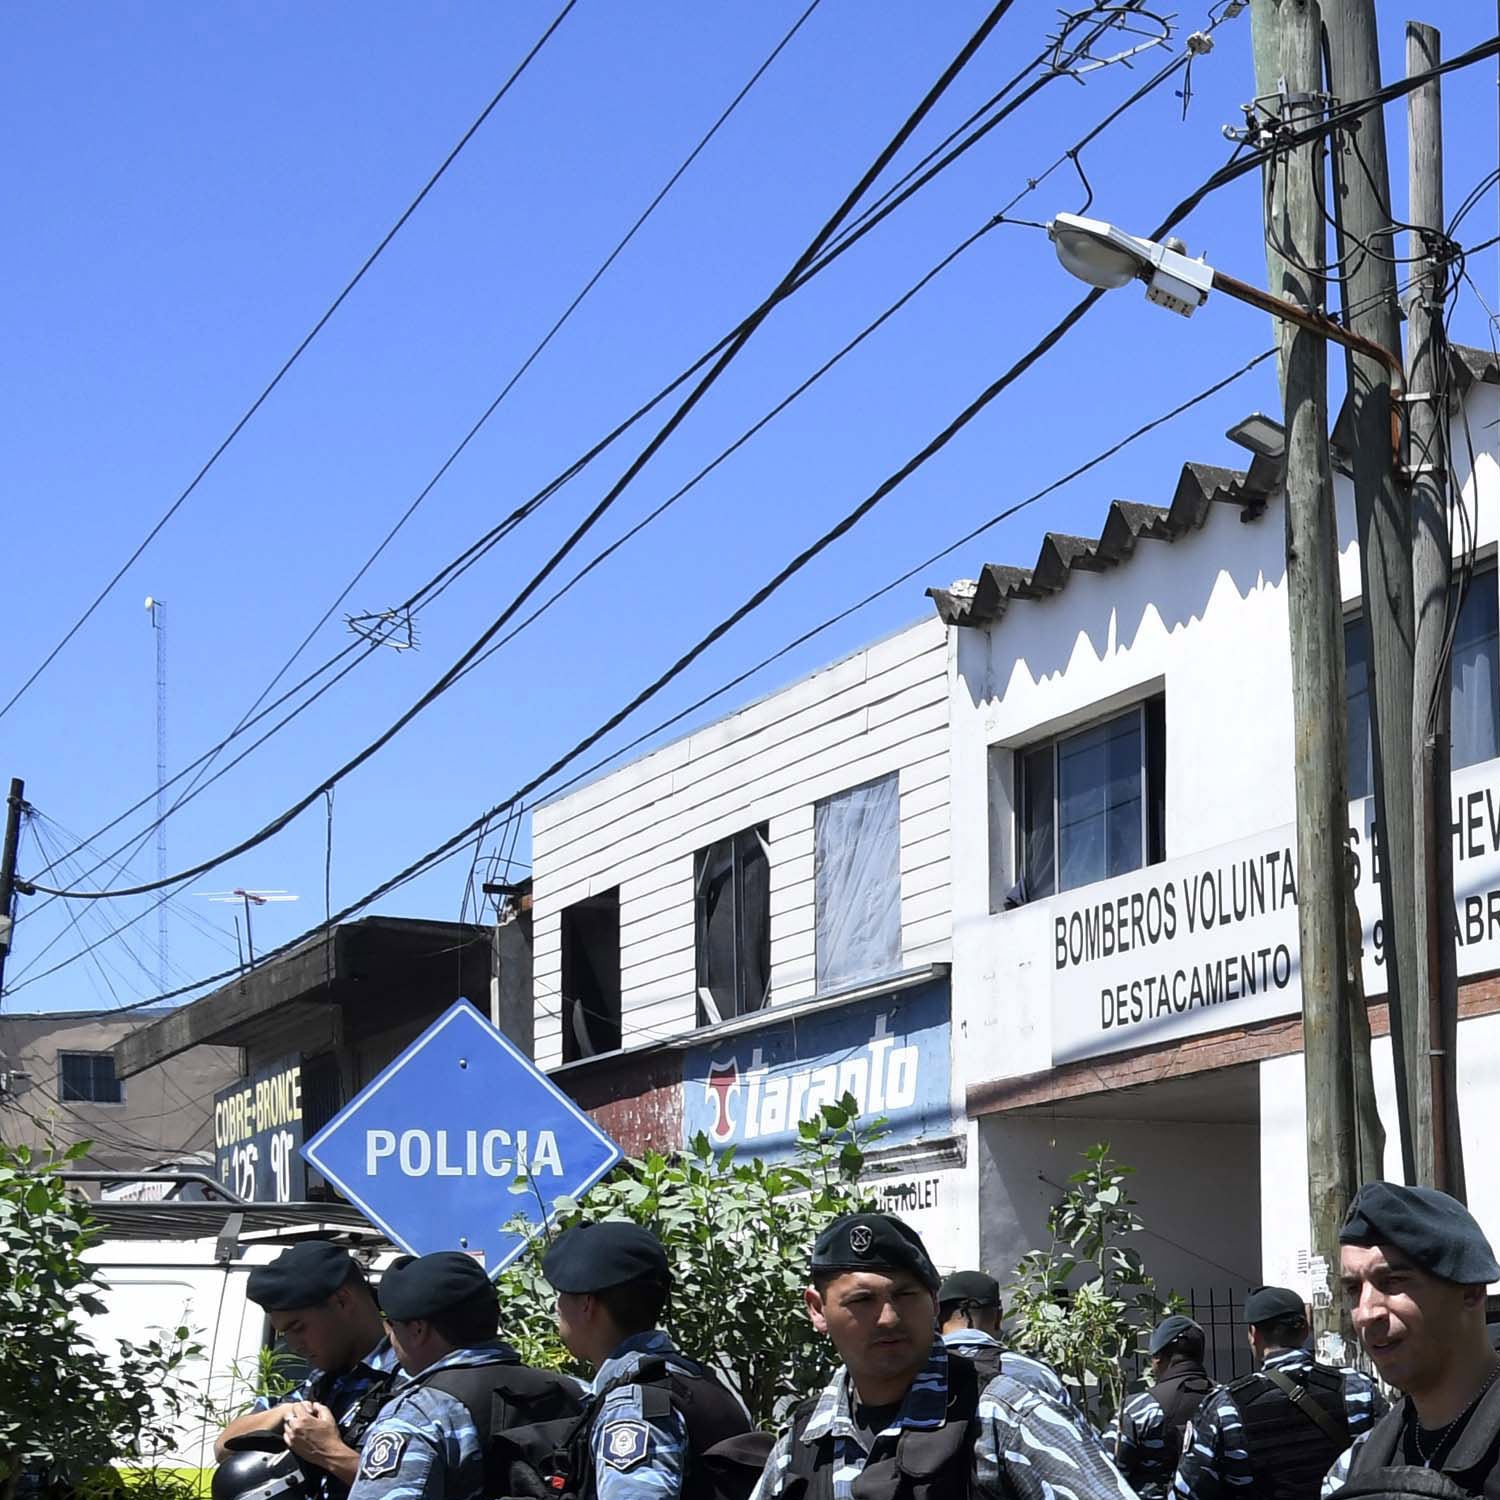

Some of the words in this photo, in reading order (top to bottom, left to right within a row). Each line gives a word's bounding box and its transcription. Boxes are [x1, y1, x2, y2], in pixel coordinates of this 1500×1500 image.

[1055, 882, 1177, 970] BOMBEROS
[1102, 944, 1291, 1029] DESTACAMENTO
[366, 1129, 564, 1177] POLICIA
